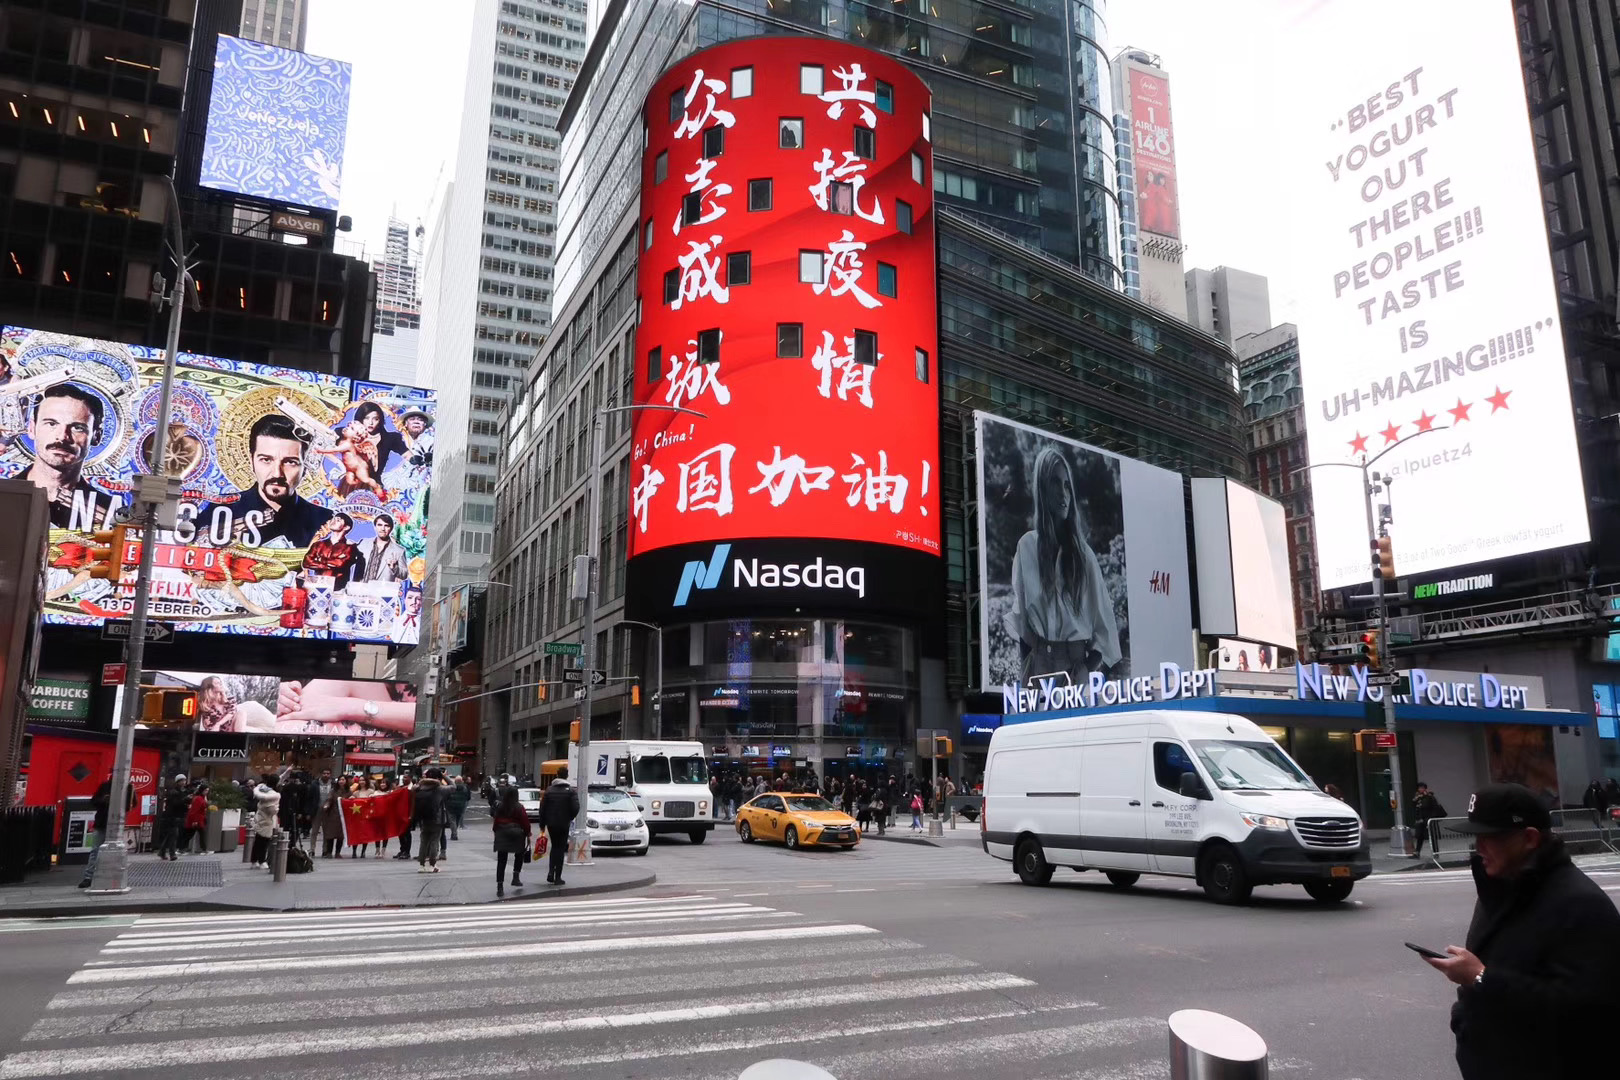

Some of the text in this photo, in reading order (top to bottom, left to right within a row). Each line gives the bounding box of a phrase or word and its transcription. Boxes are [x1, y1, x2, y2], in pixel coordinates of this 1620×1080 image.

[1148, 107, 1155, 123] 1
[1135, 120, 1169, 137] AIRLINE
[1326, 87, 1458, 183] YOGURT
[1135, 130, 1171, 155] 140
[1361, 147, 1428, 203] OUT
[277, 215, 320, 231] Absen
[1349, 177, 1454, 249] THERE
[1333, 206, 1484, 298] PEOPLE!!!
[1358, 260, 1464, 326] TASTE
[1399, 320, 1429, 354] IS
[21, 345, 70, 365] DEPARTMENT
[654, 424, 695, 449] China!
[69, 489, 264, 549] NACOS
[1476, 536, 1502, 549] Greek
[733, 557, 865, 598] Nasdaq
[1149, 570, 1171, 596] H&M
[123, 578, 193, 598] NTFLIX
[102, 600, 118, 610] 13
[547, 643, 580, 655] Broadway
[31, 685, 88, 698] TARBUCKS
[1003, 661, 1216, 714] NEW YORK POLICE DEPT
[1296, 660, 1349, 700] NEW
[1409, 668, 1477, 708] POLICE
[1480, 673, 1528, 710] DEPT
[32, 699, 74, 710] COFFEE
[281, 724, 340, 735] CAPELLA
[751, 721, 776, 730] Nasdaq
[198, 747, 247, 759] CITIZEN
[1467, 793, 1477, 813] B
